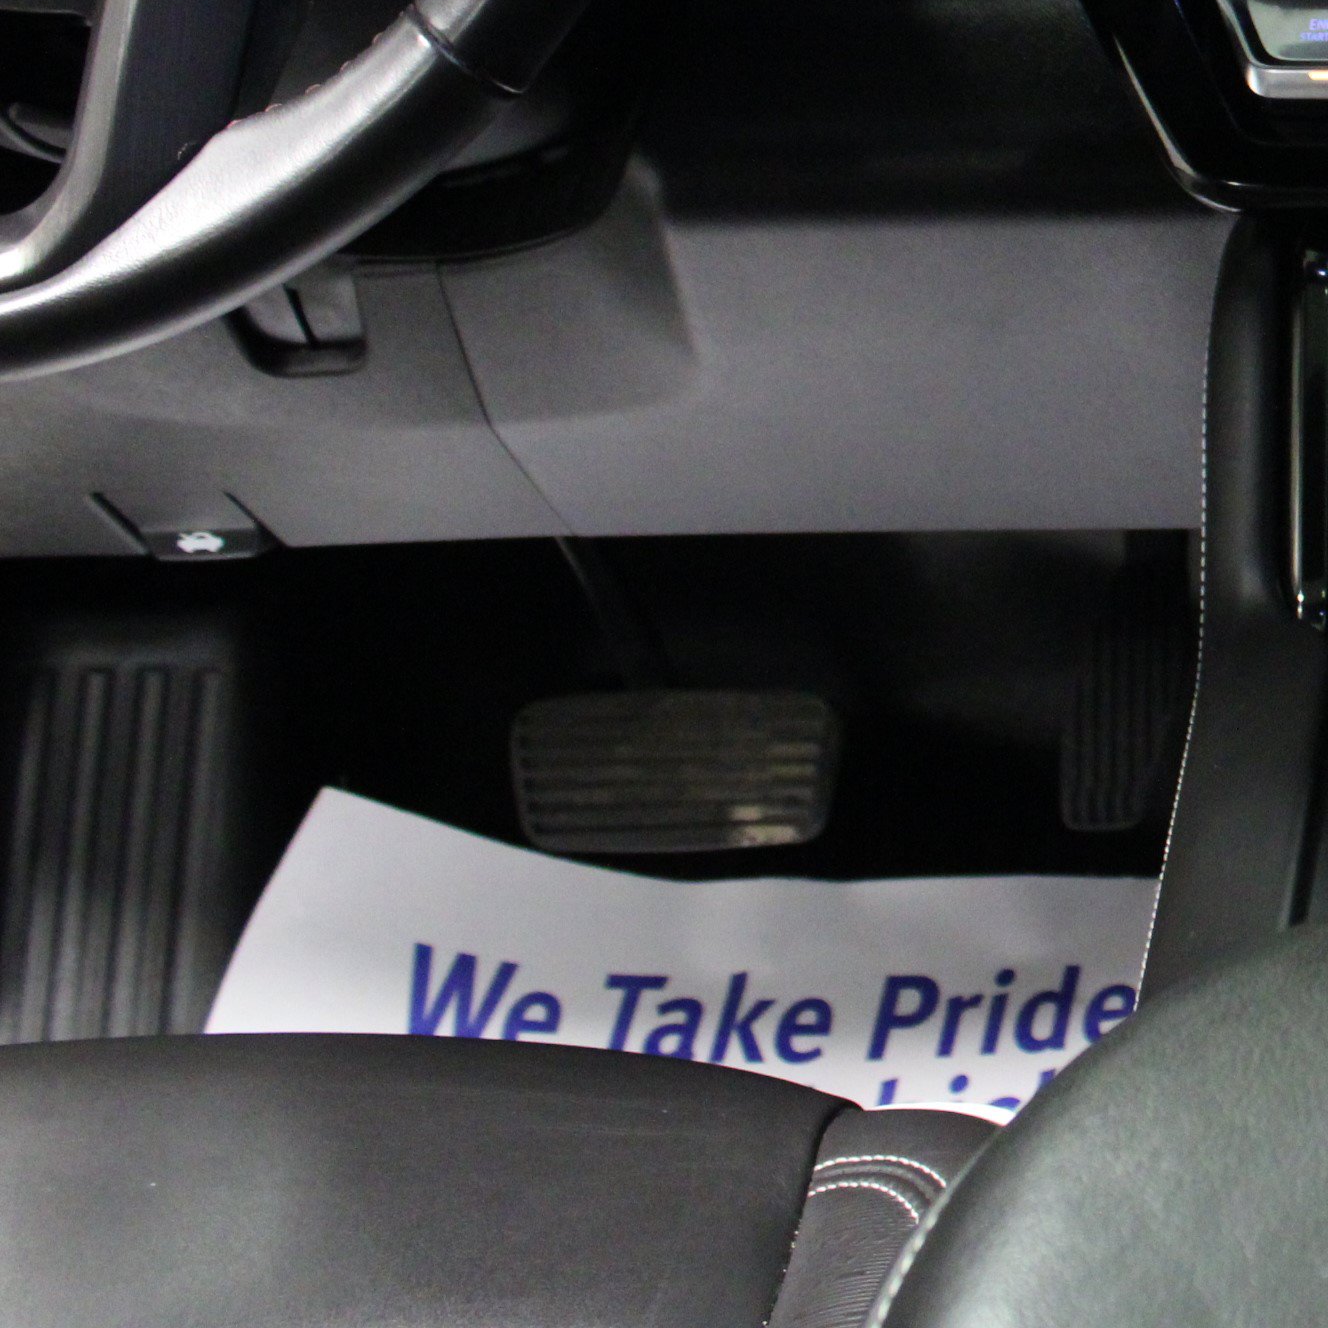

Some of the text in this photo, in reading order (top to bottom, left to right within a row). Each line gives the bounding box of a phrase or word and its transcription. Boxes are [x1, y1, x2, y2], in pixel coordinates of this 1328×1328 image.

[408, 942, 1137, 1065] We Take Pride
